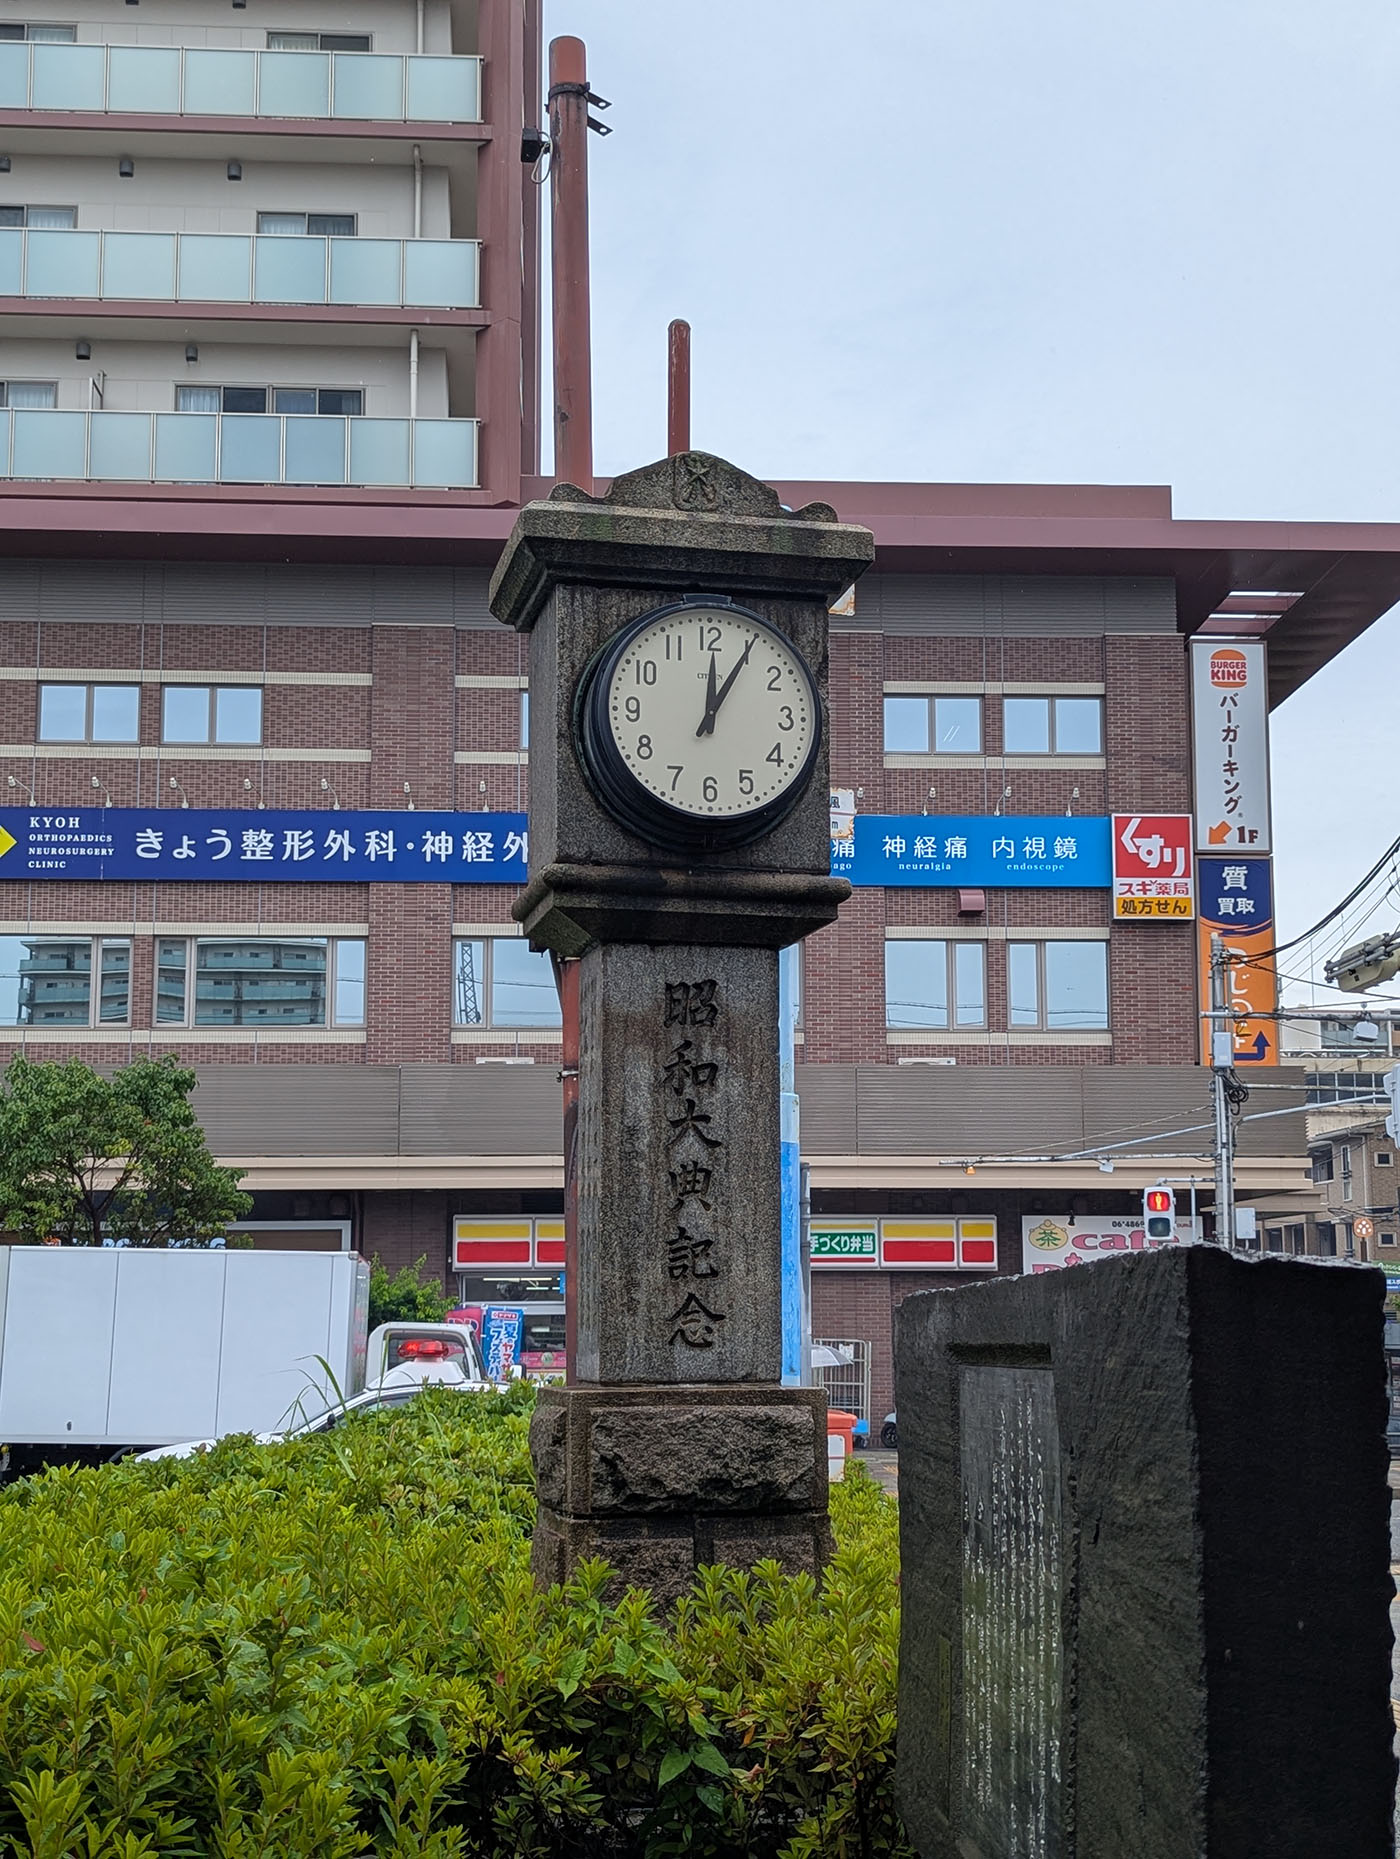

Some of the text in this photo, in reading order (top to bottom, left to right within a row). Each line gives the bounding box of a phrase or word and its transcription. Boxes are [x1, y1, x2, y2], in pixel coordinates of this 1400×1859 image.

[665, 634, 682, 661] 11
[699, 626, 722, 652] 12
[635, 659, 658, 686] 10
[1210, 661, 1247, 670] BURGER
[1210, 669, 1247, 681] KING
[766, 665, 782, 692] 2
[624, 696, 641, 723] 9
[777, 705, 795, 732] 3
[636, 734, 653, 760] 8
[765, 742, 785, 768] 4
[1220, 692, 1242, 815] バーガーキング
[666, 765, 684, 792] 7
[702, 776, 718, 803] 6
[738, 769, 754, 795] 5
[29, 817, 80, 828] KYOH
[1236, 826, 1258, 844] 1F
[29, 834, 113, 842] ORTHOPAEDICS
[881, 835, 968, 859] 神経痛
[992, 835, 1079, 860] 内視鏡
[1120, 818, 1186, 877] くすり
[28, 847, 115, 856] NEUROSURGERY
[831, 862, 852, 872] ago
[899, 862, 952, 872] neuralgia
[1006, 862, 1065, 873] endoscope
[1222, 866, 1249, 891] 質
[1118, 880, 1189, 896] スギ薬局
[1121, 899, 1187, 915] 処方せん
[1217, 897, 1256, 916] 買取
[664, 978, 725, 1349] 昭和大典記念
[1035, 1230, 1062, 1247] 茶
